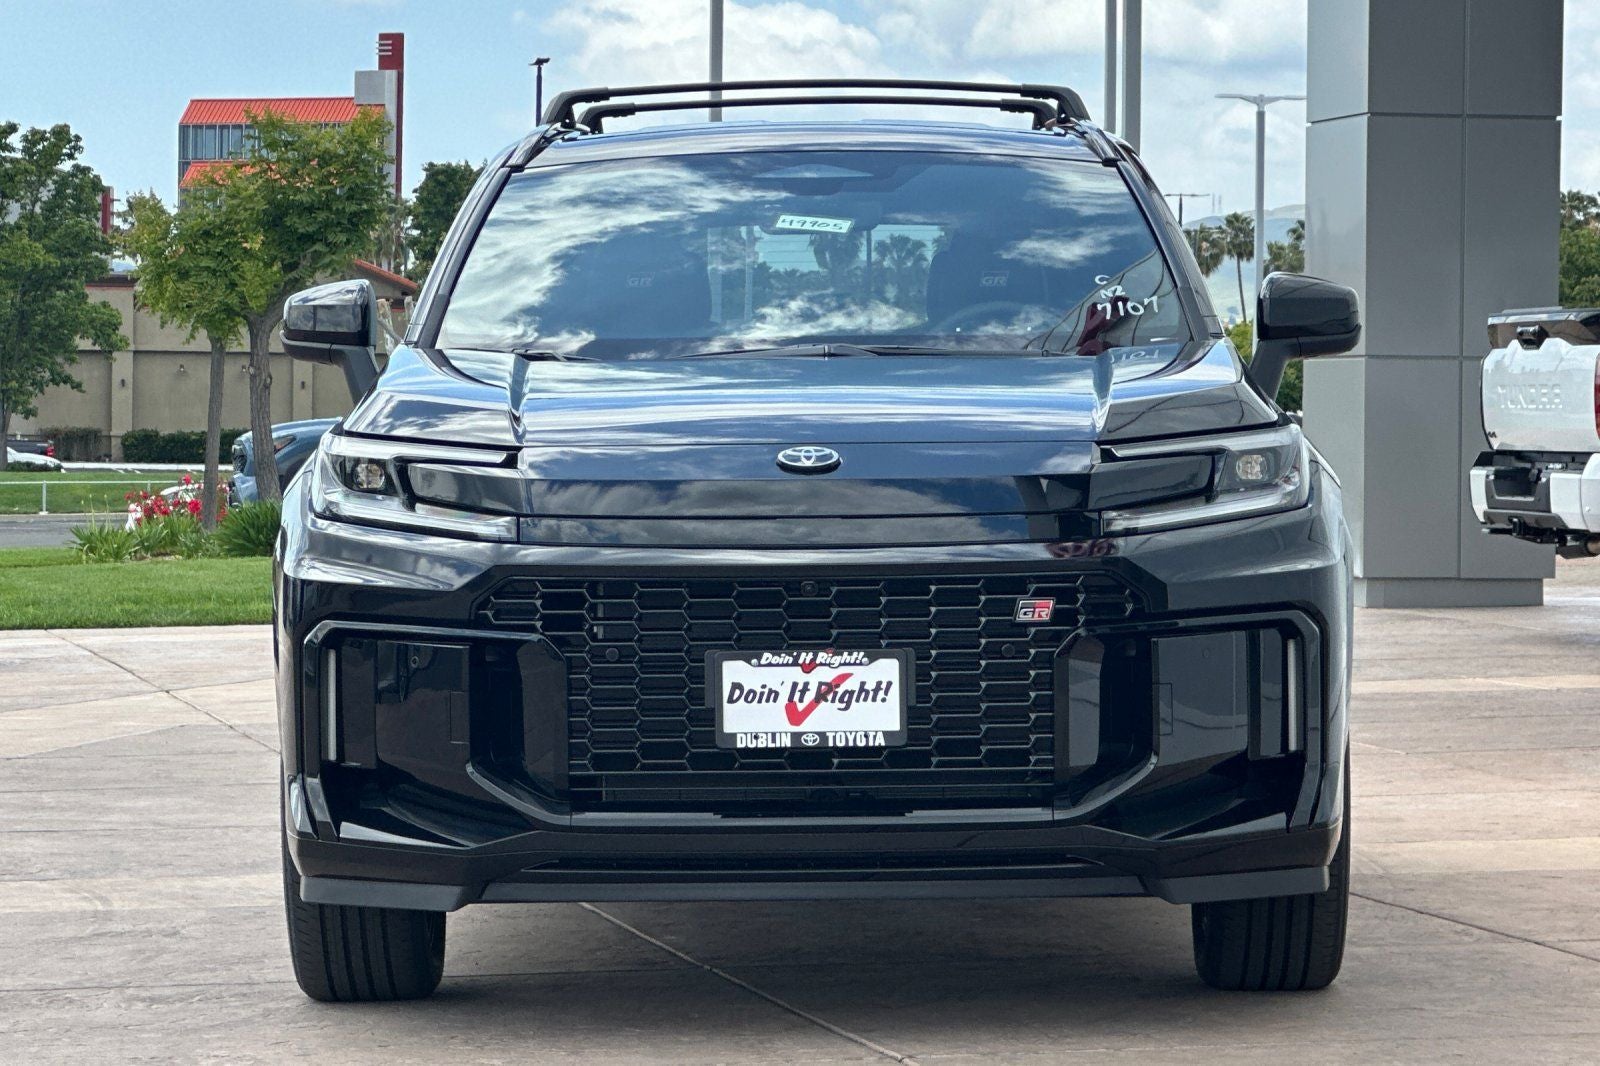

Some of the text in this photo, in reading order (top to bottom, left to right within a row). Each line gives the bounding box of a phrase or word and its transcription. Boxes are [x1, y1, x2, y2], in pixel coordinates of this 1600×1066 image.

[1097, 295, 1159, 320] 7107
[1497, 384, 1563, 409] TUNDRA
[799, 651, 815, 665] It
[815, 651, 863, 668] Right!
[726, 680, 893, 711] Doin' It Right!
[736, 731, 886, 748] DUBLIN TOYOTA
